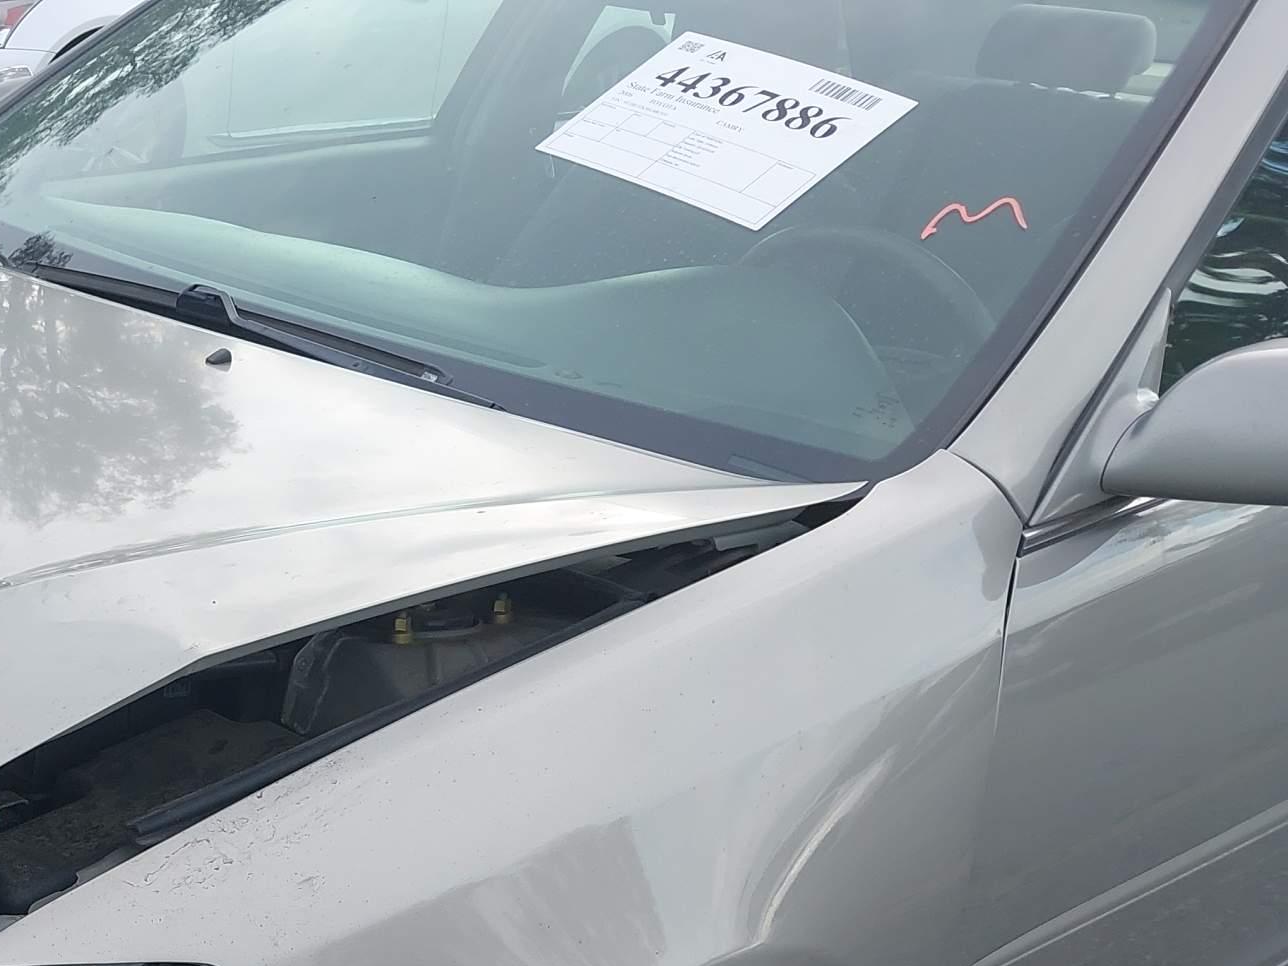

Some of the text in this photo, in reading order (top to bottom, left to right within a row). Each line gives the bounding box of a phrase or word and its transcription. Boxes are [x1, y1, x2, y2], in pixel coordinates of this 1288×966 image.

[628, 81, 650, 93] State
[651, 88, 674, 100] Farm
[676, 95, 720, 114] Insurance
[655, 66, 852, 139] 44367886
